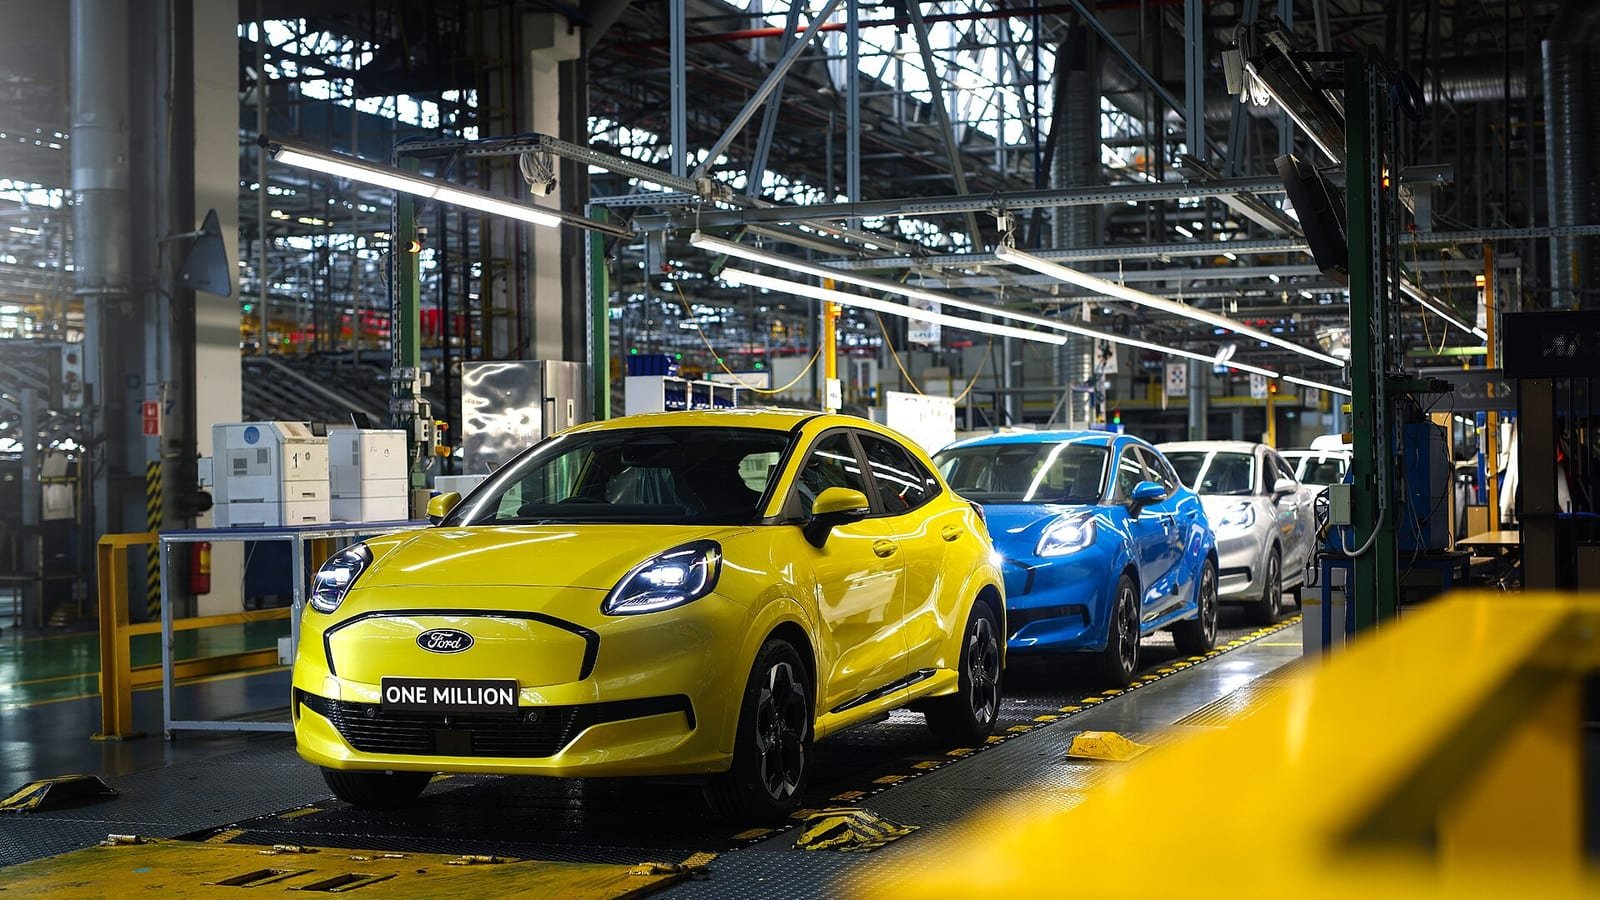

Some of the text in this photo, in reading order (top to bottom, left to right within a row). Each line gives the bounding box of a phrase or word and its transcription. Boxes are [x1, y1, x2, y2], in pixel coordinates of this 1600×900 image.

[427, 631, 462, 649] Ford
[386, 686, 514, 706] ONE MILLION
